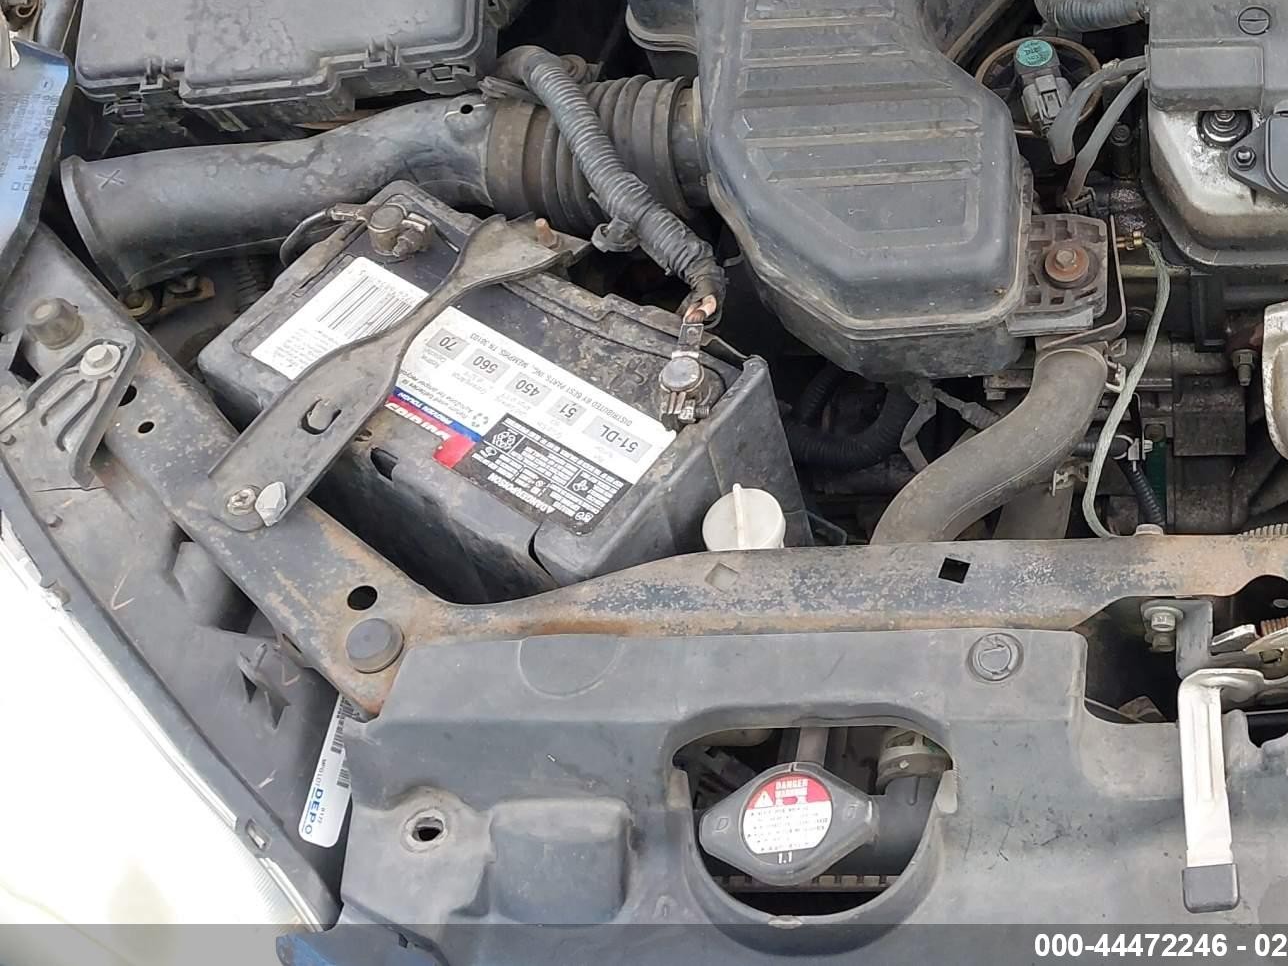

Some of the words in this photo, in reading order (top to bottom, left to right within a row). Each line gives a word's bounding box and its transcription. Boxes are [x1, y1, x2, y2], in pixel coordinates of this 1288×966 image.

[437, 334, 458, 350] 70
[471, 354, 499, 374] 560
[513, 377, 542, 398] 450
[563, 385, 583, 399] BEST
[396, 390, 423, 408] TOUGH
[421, 404, 453, 425] PROVEN
[557, 403, 578, 418] 51
[589, 400, 633, 427] DISTRIBUTED
[595, 423, 639, 455] 51-DL
[305, 789, 324, 834] DEPO
